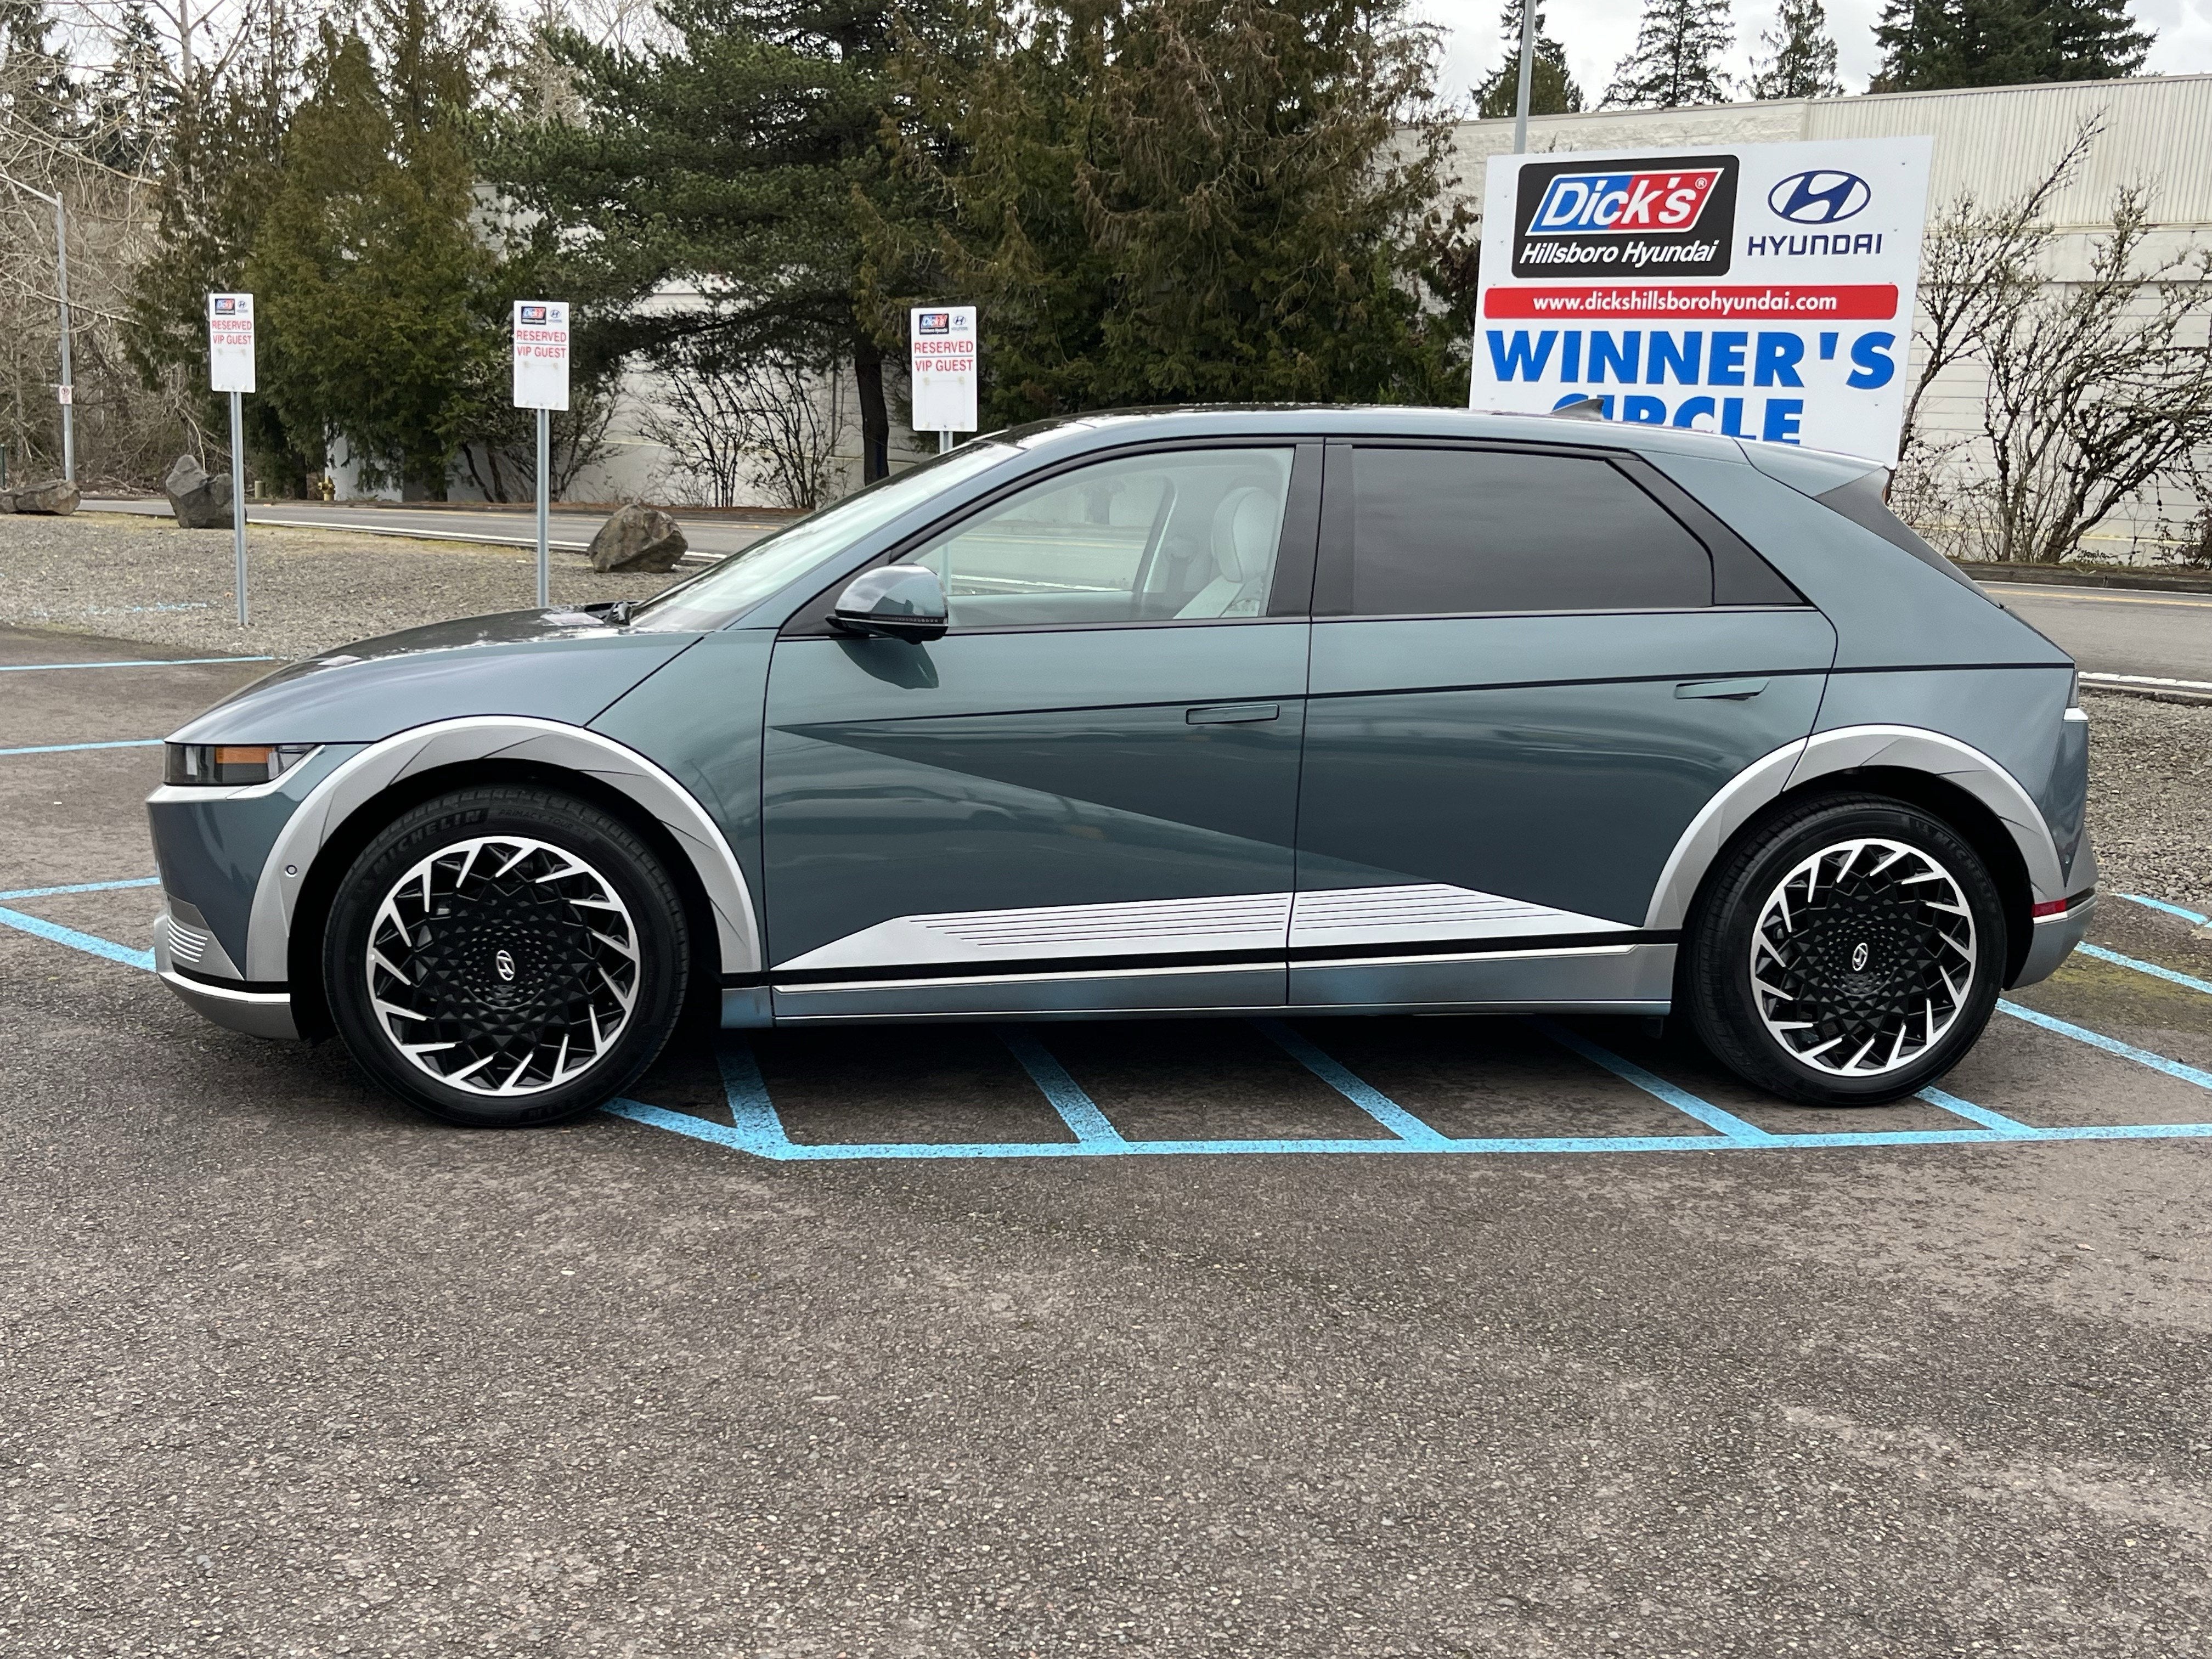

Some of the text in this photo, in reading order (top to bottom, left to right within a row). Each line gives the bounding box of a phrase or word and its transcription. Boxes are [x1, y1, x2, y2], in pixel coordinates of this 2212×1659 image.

[1541, 177, 1697, 227] Dick's
[1747, 233, 1883, 256] HYUNDAI
[1519, 239, 1719, 268] Hillsboro Hyundai
[1533, 290, 1837, 316] www.dickshillsborohyundai.com
[212, 320, 252, 330] RESERVED
[213, 335, 252, 345] VIP GUEST
[516, 330, 567, 342] RESERVED
[516, 346, 567, 358] VIP GUEST
[914, 340, 974, 354] RESERVED
[915, 359, 973, 372] VIP GUEST
[1486, 330, 1897, 390] WINNER'S
